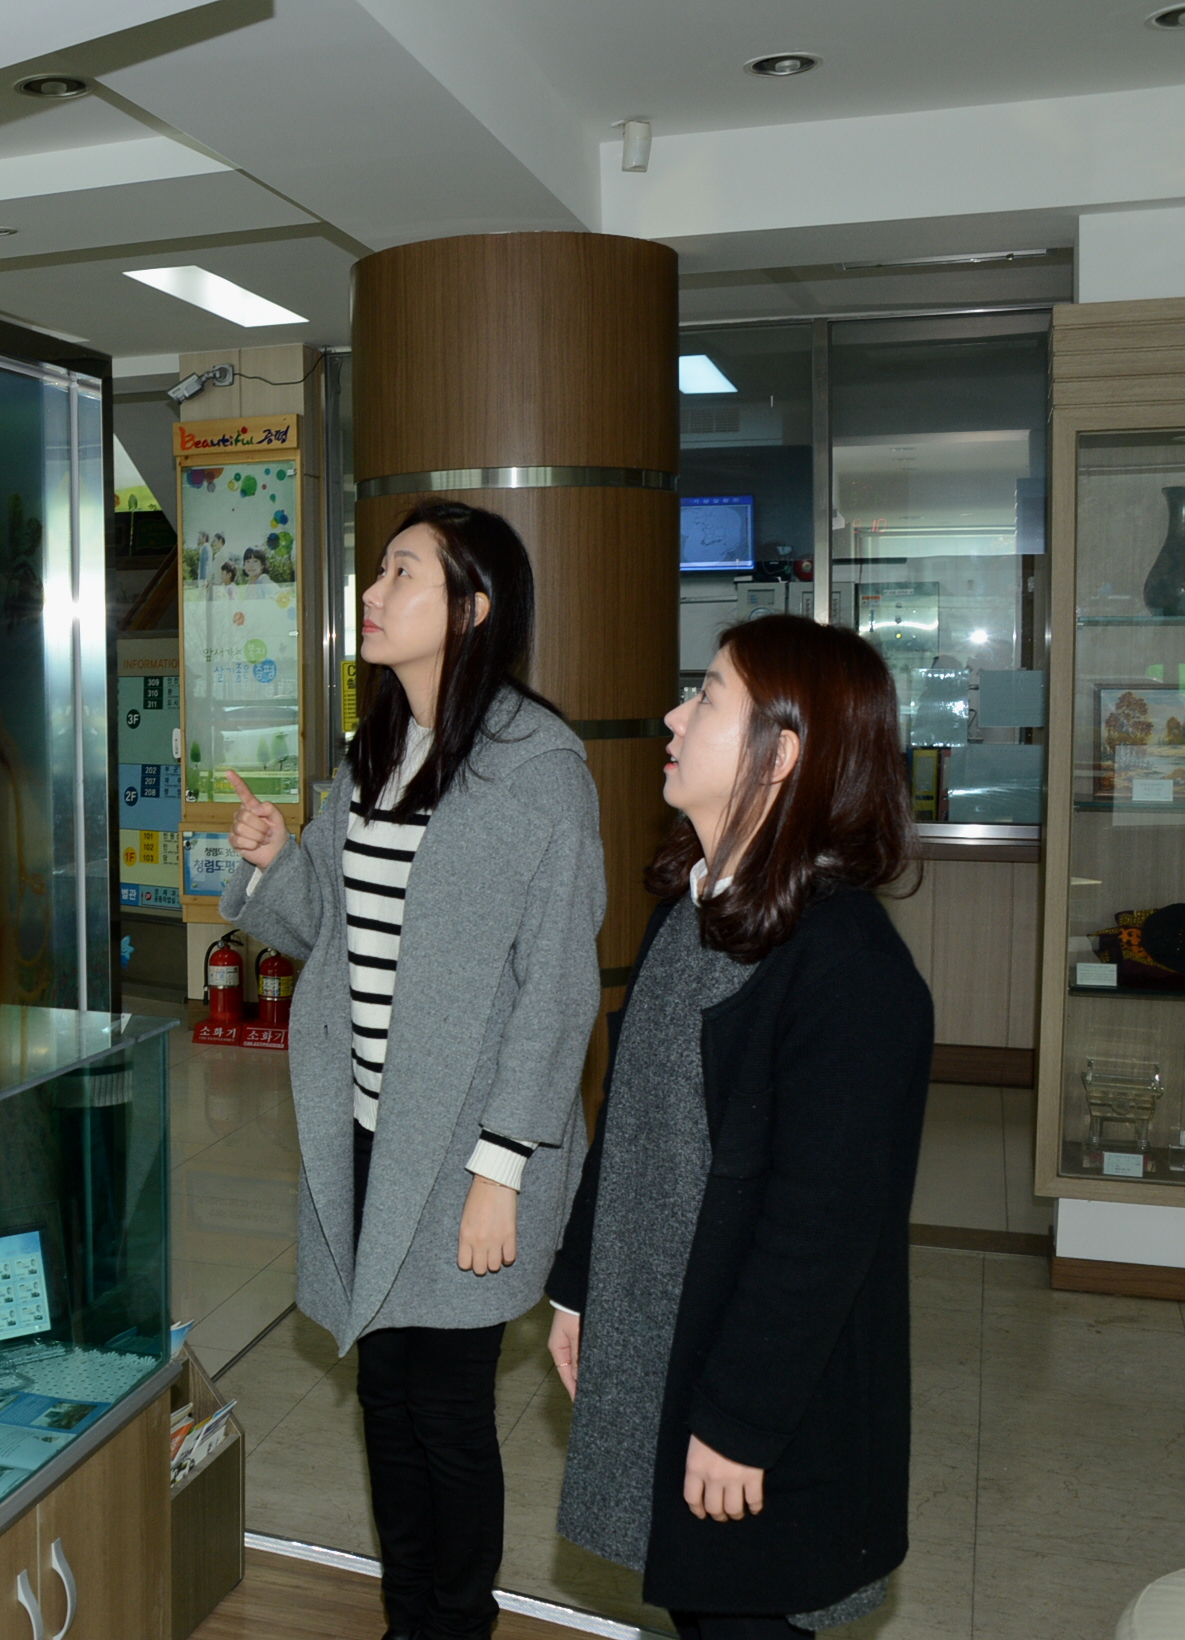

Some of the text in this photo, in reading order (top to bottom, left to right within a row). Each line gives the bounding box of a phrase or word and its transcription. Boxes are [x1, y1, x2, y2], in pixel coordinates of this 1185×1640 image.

[179, 426, 254, 451] Beautiful
[203, 643, 265, 662] 앞서가는 복지
[256, 664, 276, 680] 증평
[127, 713, 140, 725] 3F
[125, 790, 137, 802] 2F
[125, 852, 136, 863] 1F
[121, 888, 138, 901] 별관
[199, 1026, 237, 1039] 소화기
[247, 1030, 286, 1044] 소화기
